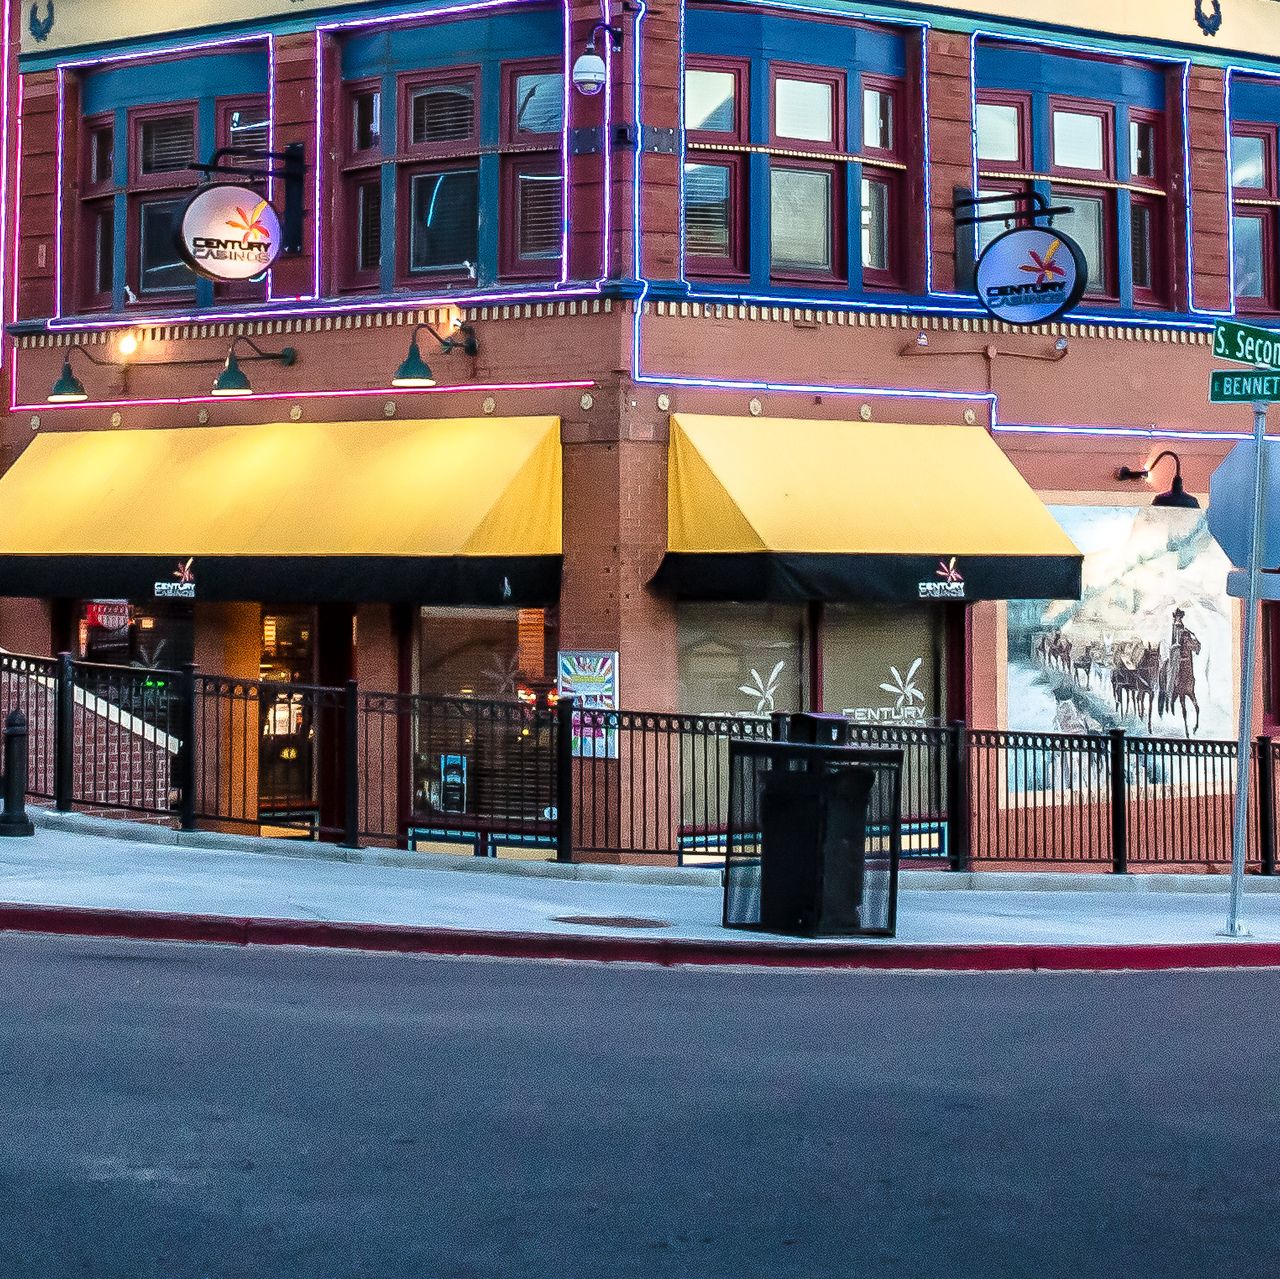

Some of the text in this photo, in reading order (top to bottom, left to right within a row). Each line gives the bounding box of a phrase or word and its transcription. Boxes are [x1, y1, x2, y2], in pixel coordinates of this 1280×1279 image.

[193, 237, 271, 252] CENTURY
[193, 248, 269, 263] CASINOS
[986, 281, 1067, 297] CENTURY
[1216, 326, 1229, 355] S.
[155, 582, 195, 590] CENTURY
[919, 582, 965, 590] CENTURY
[842, 706, 927, 720] CENTURY
